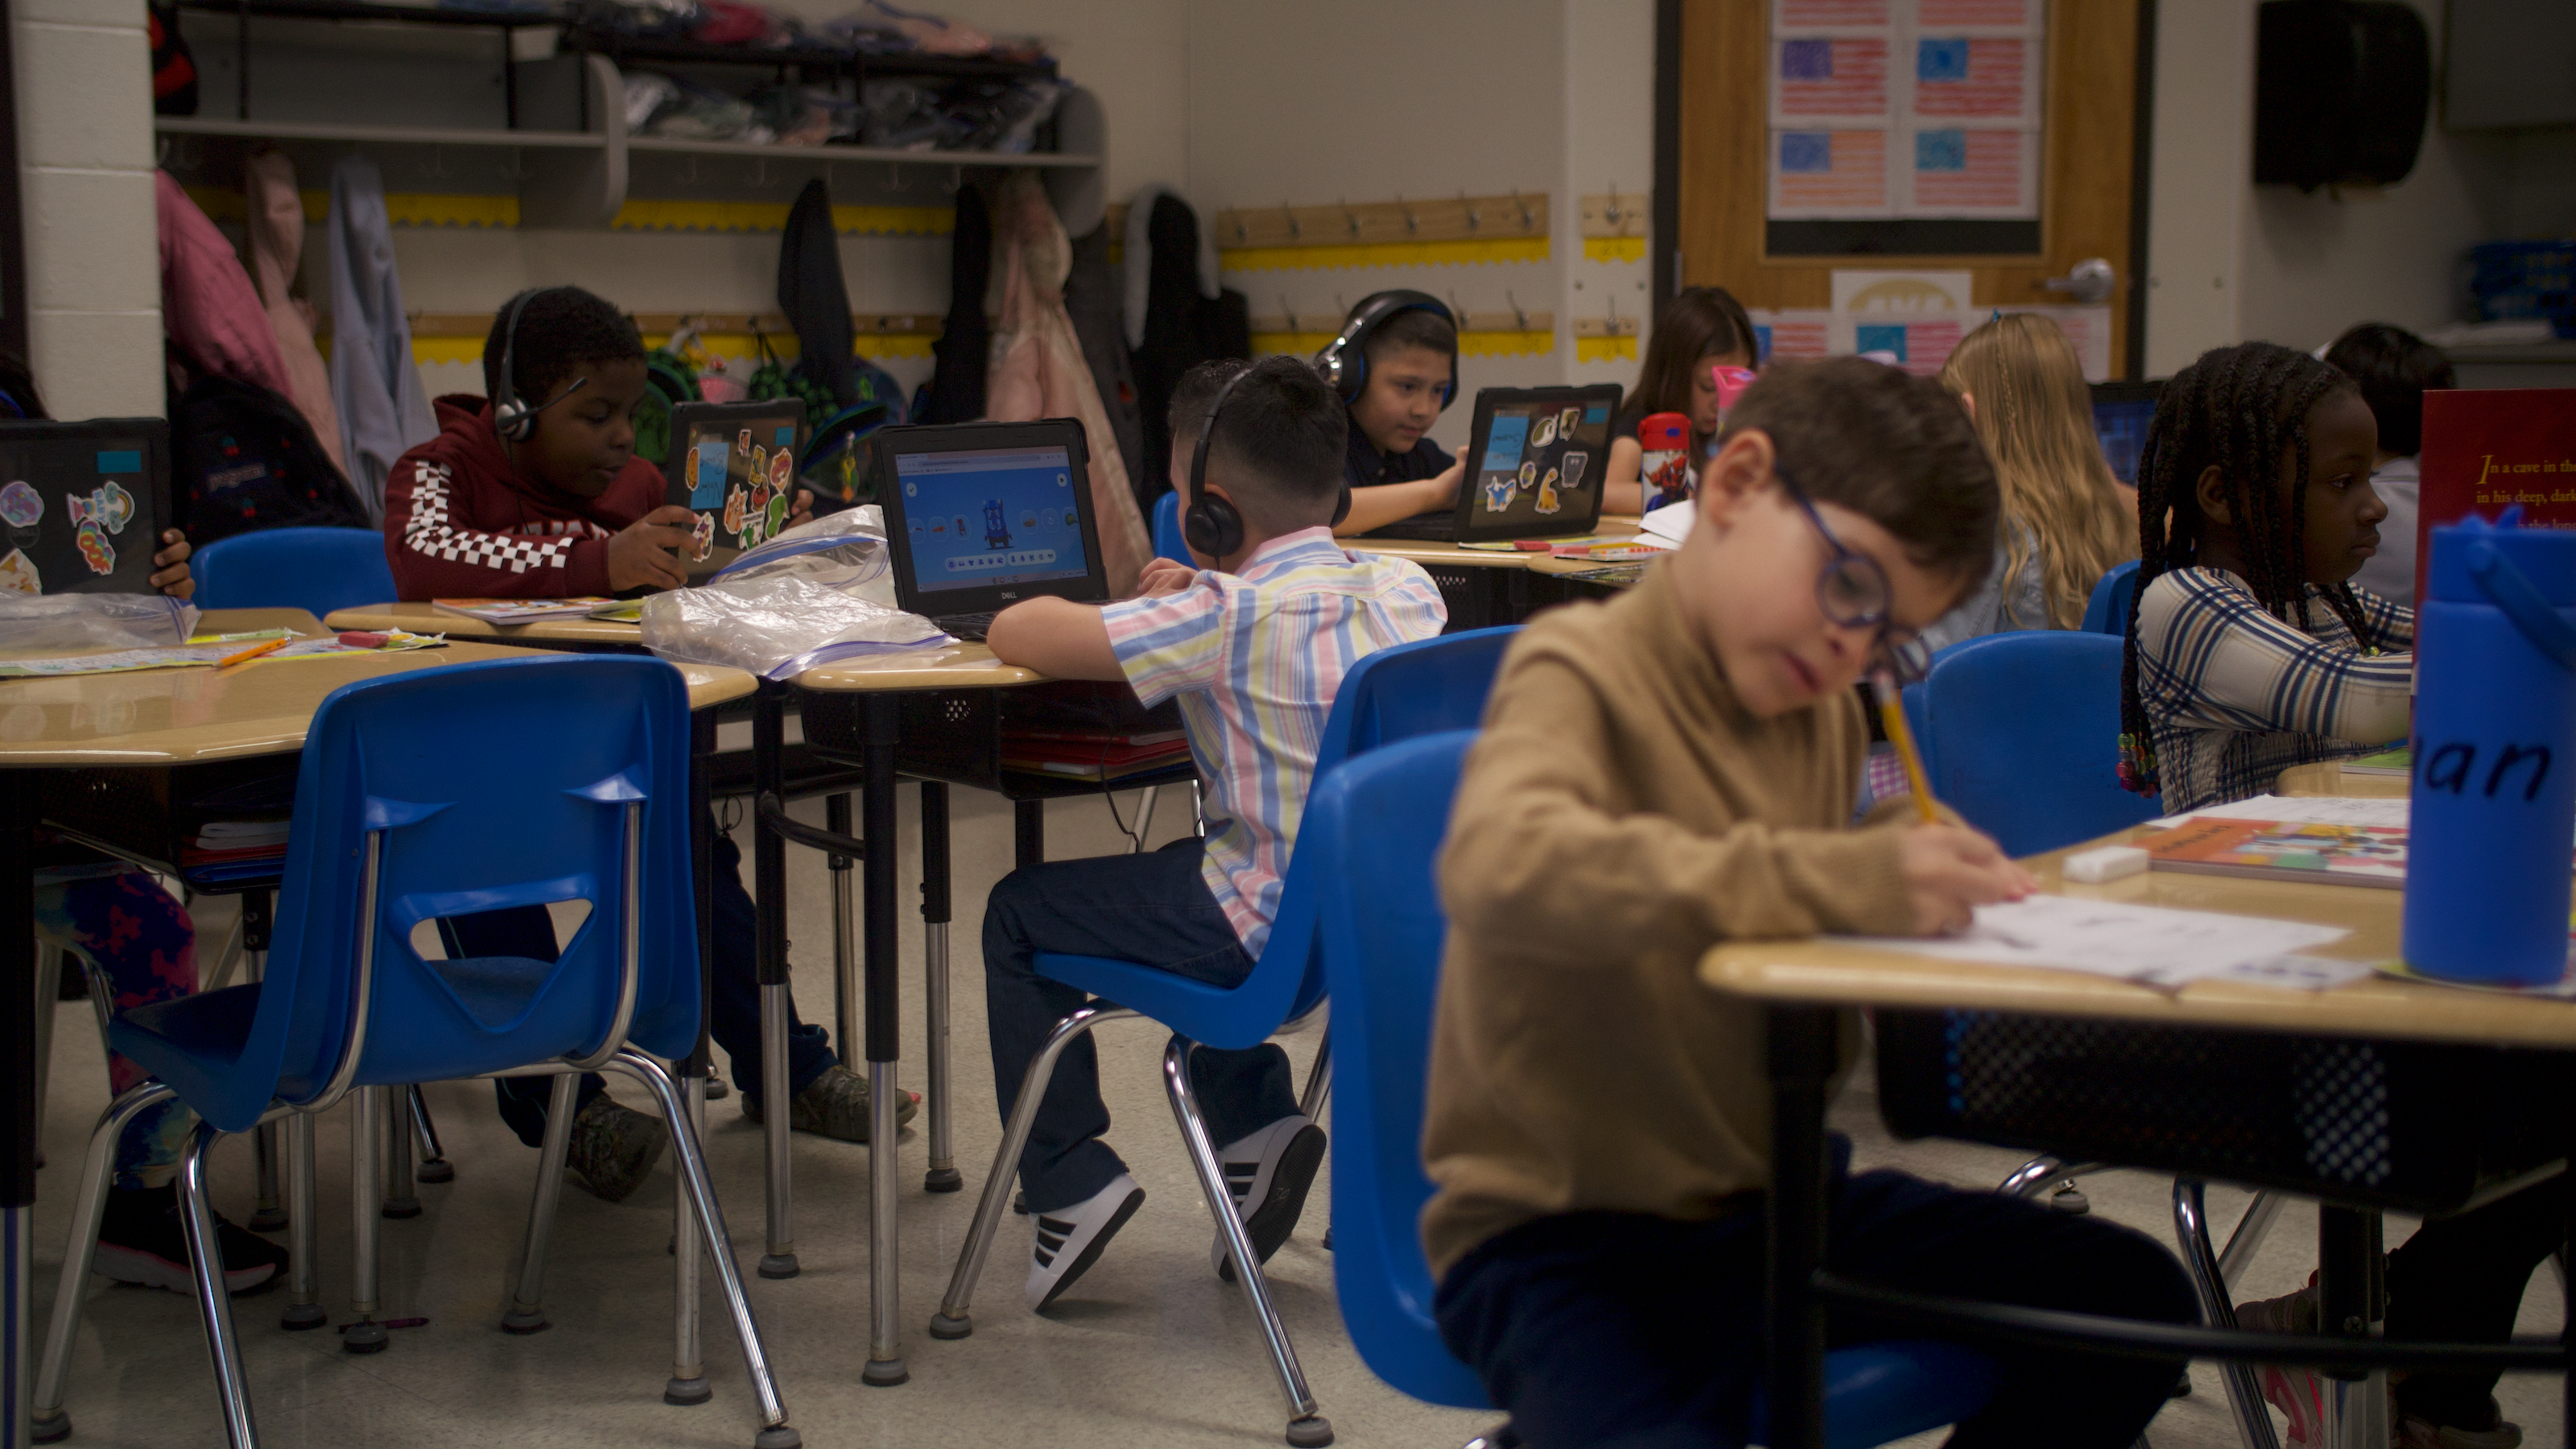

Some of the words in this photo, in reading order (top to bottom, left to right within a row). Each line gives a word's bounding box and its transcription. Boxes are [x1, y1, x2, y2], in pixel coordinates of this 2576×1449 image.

[2475, 453, 2500, 485] In
[2501, 464, 2511, 473] a
[2512, 464, 2541, 473] cave
[2543, 460, 2557, 473] in
[2476, 490, 2490, 504] in
[2492, 489, 2512, 503] his
[2514, 489, 2548, 507] deep,
[1001, 591, 1018, 600] DELL
[2415, 736, 2551, 801] an
